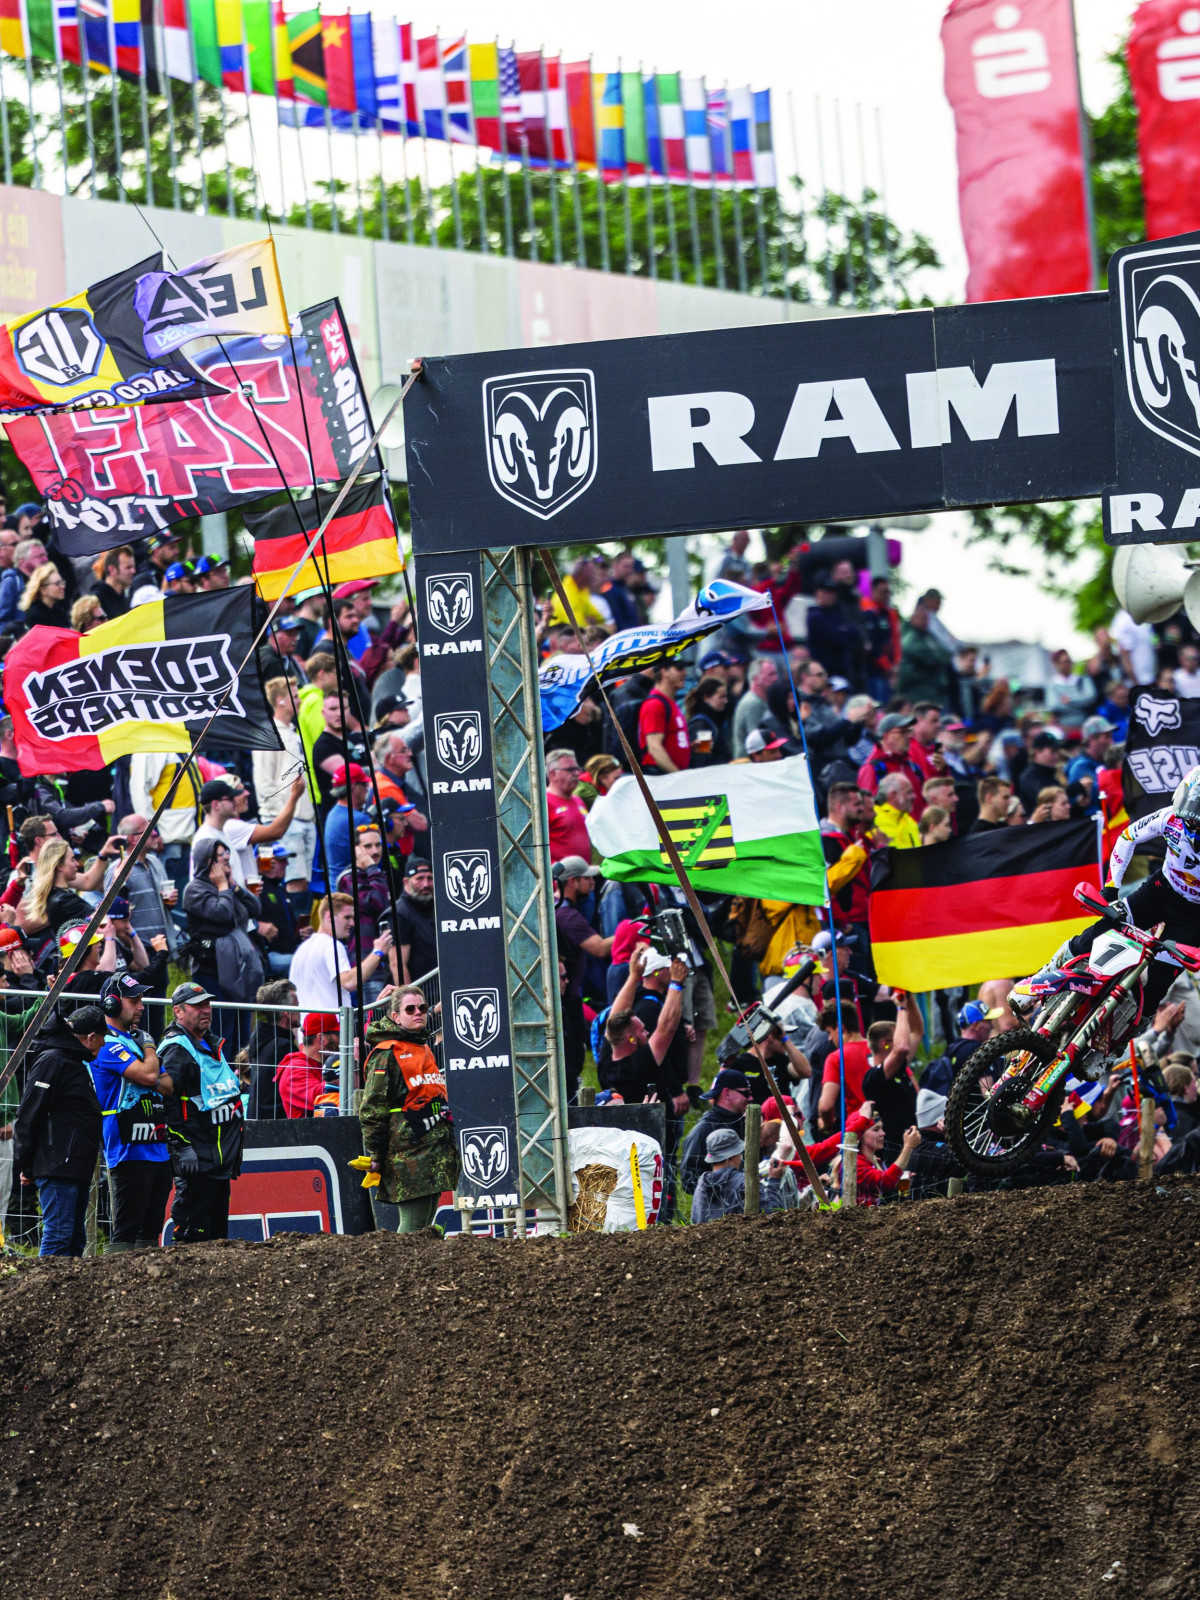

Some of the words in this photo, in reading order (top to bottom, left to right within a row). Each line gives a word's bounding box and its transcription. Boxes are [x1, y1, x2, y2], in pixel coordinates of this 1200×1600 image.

[648, 359, 1059, 471] RAM
[424, 640, 482, 656] RAM
[433, 778, 491, 794] RAM
[441, 917, 500, 932] RAM
[1093, 943, 1127, 967] 1
[450, 1055, 509, 1070] RAM
[458, 1193, 518, 1209] RAM
